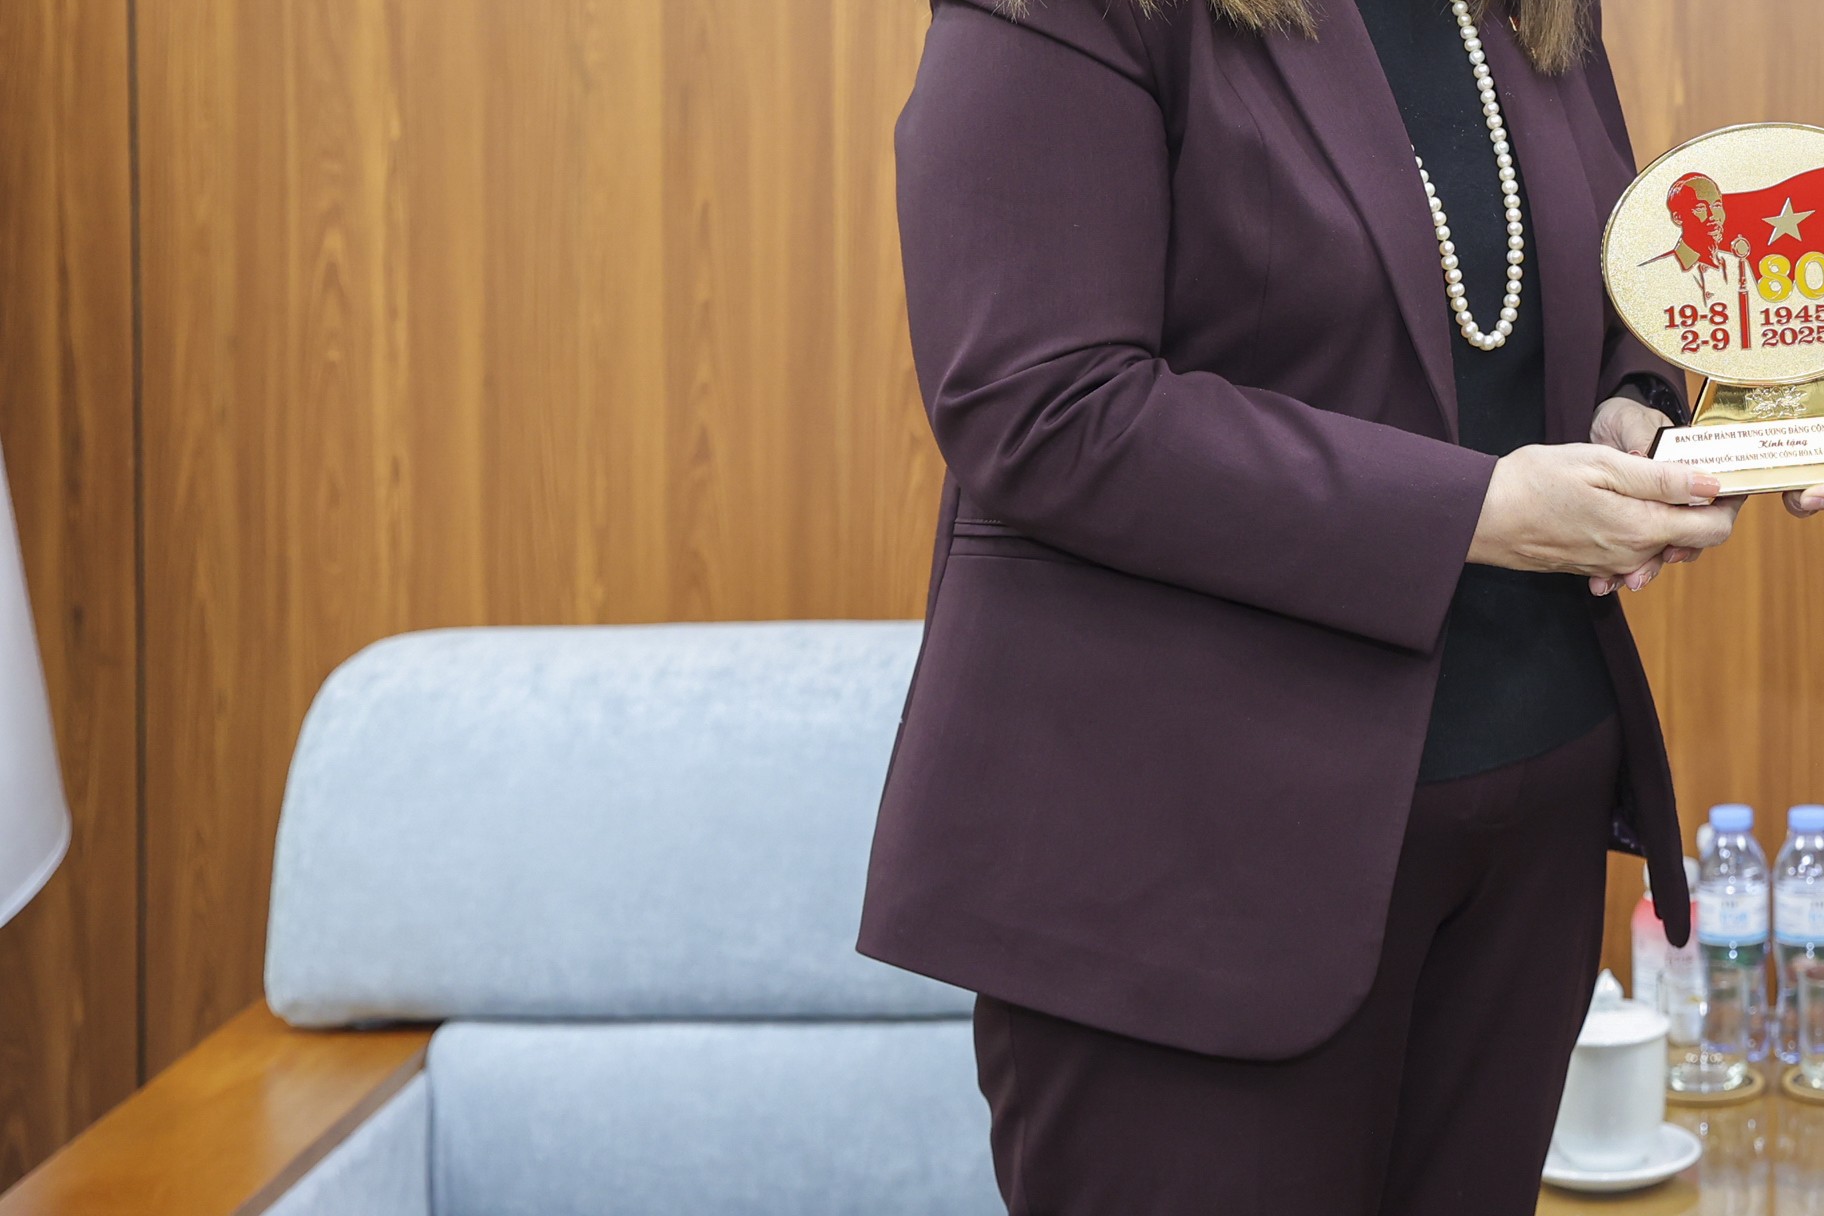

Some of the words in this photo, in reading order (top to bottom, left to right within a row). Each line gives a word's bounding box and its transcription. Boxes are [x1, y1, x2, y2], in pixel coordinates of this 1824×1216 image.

[1663, 302, 1729, 330] 19-8
[1680, 327, 1731, 354] 2-9
[1675, 434, 1691, 443] BAN
[1737, 429, 1764, 438] TRUNG
